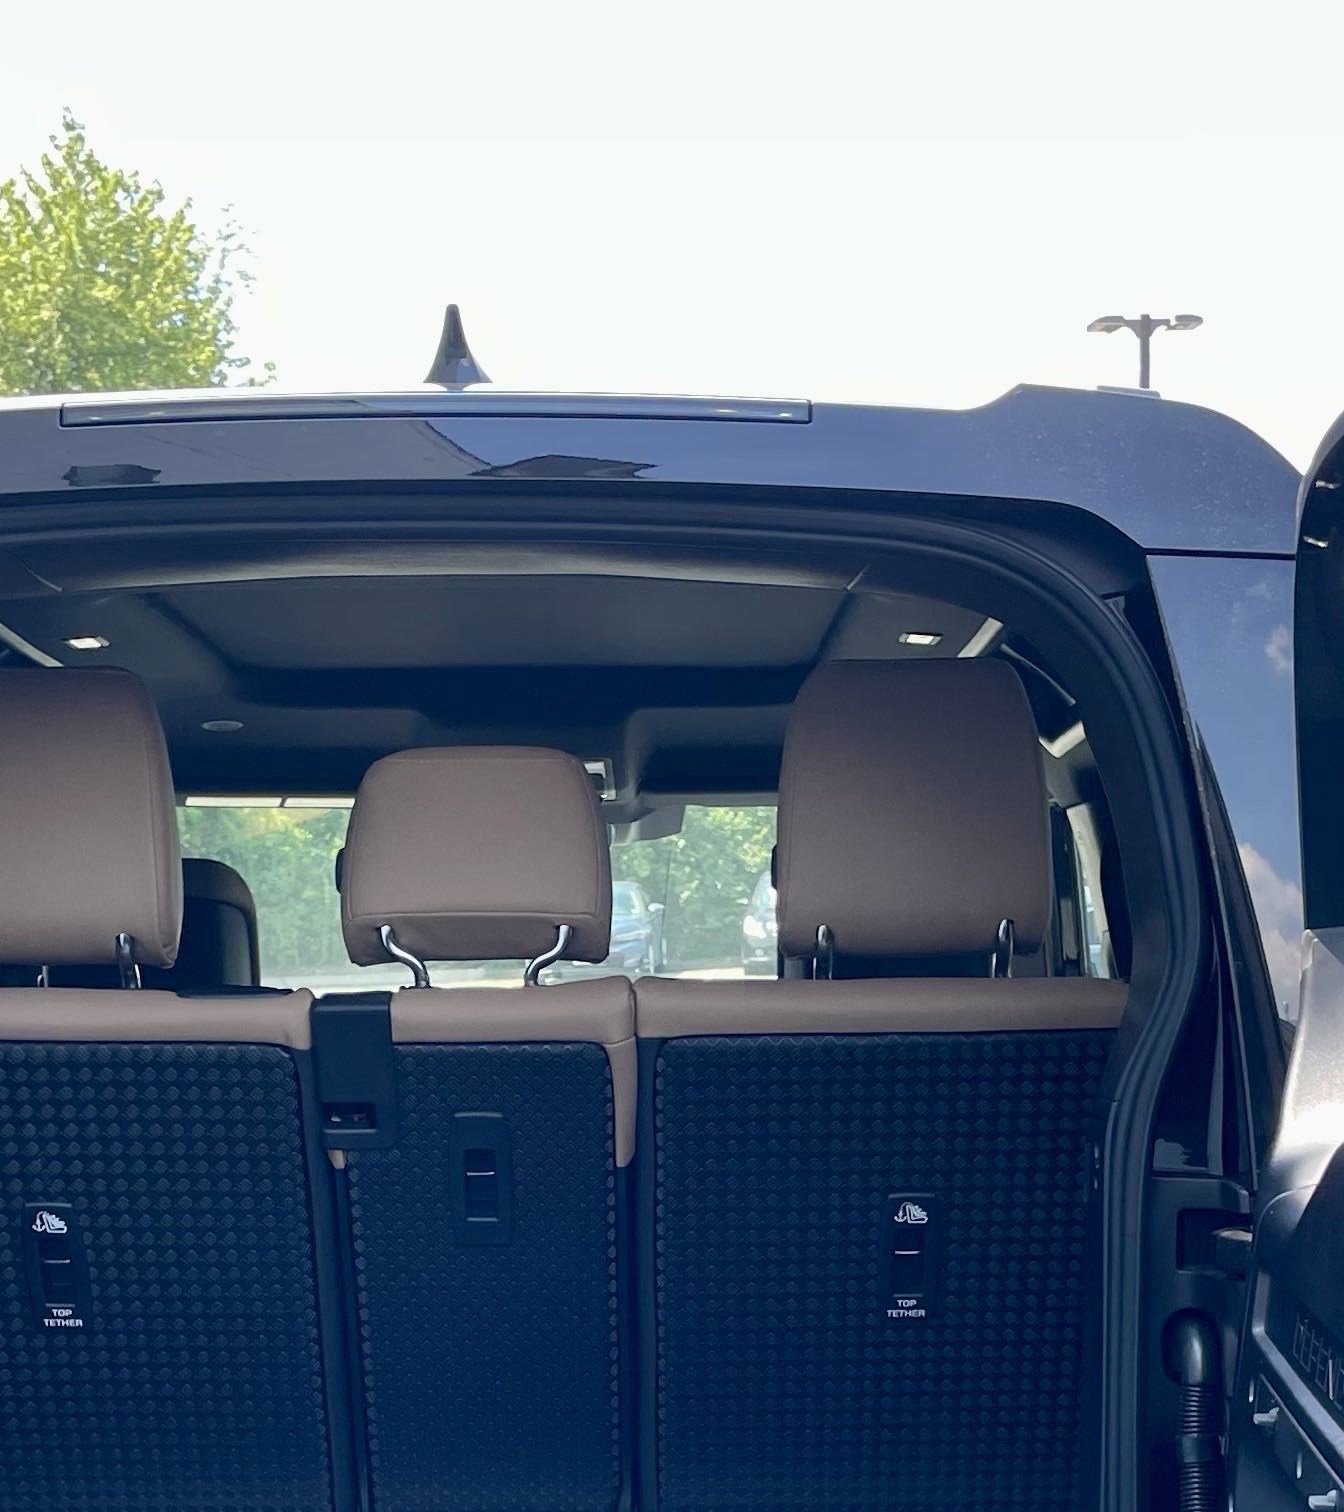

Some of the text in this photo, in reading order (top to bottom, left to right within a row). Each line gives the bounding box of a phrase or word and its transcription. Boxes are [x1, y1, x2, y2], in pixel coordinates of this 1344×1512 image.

[897, 1299, 917, 1308] TOP
[51, 1308, 73, 1317] TOP
[886, 1309, 926, 1318] TETHER
[43, 1318, 83, 1327] TETHER
